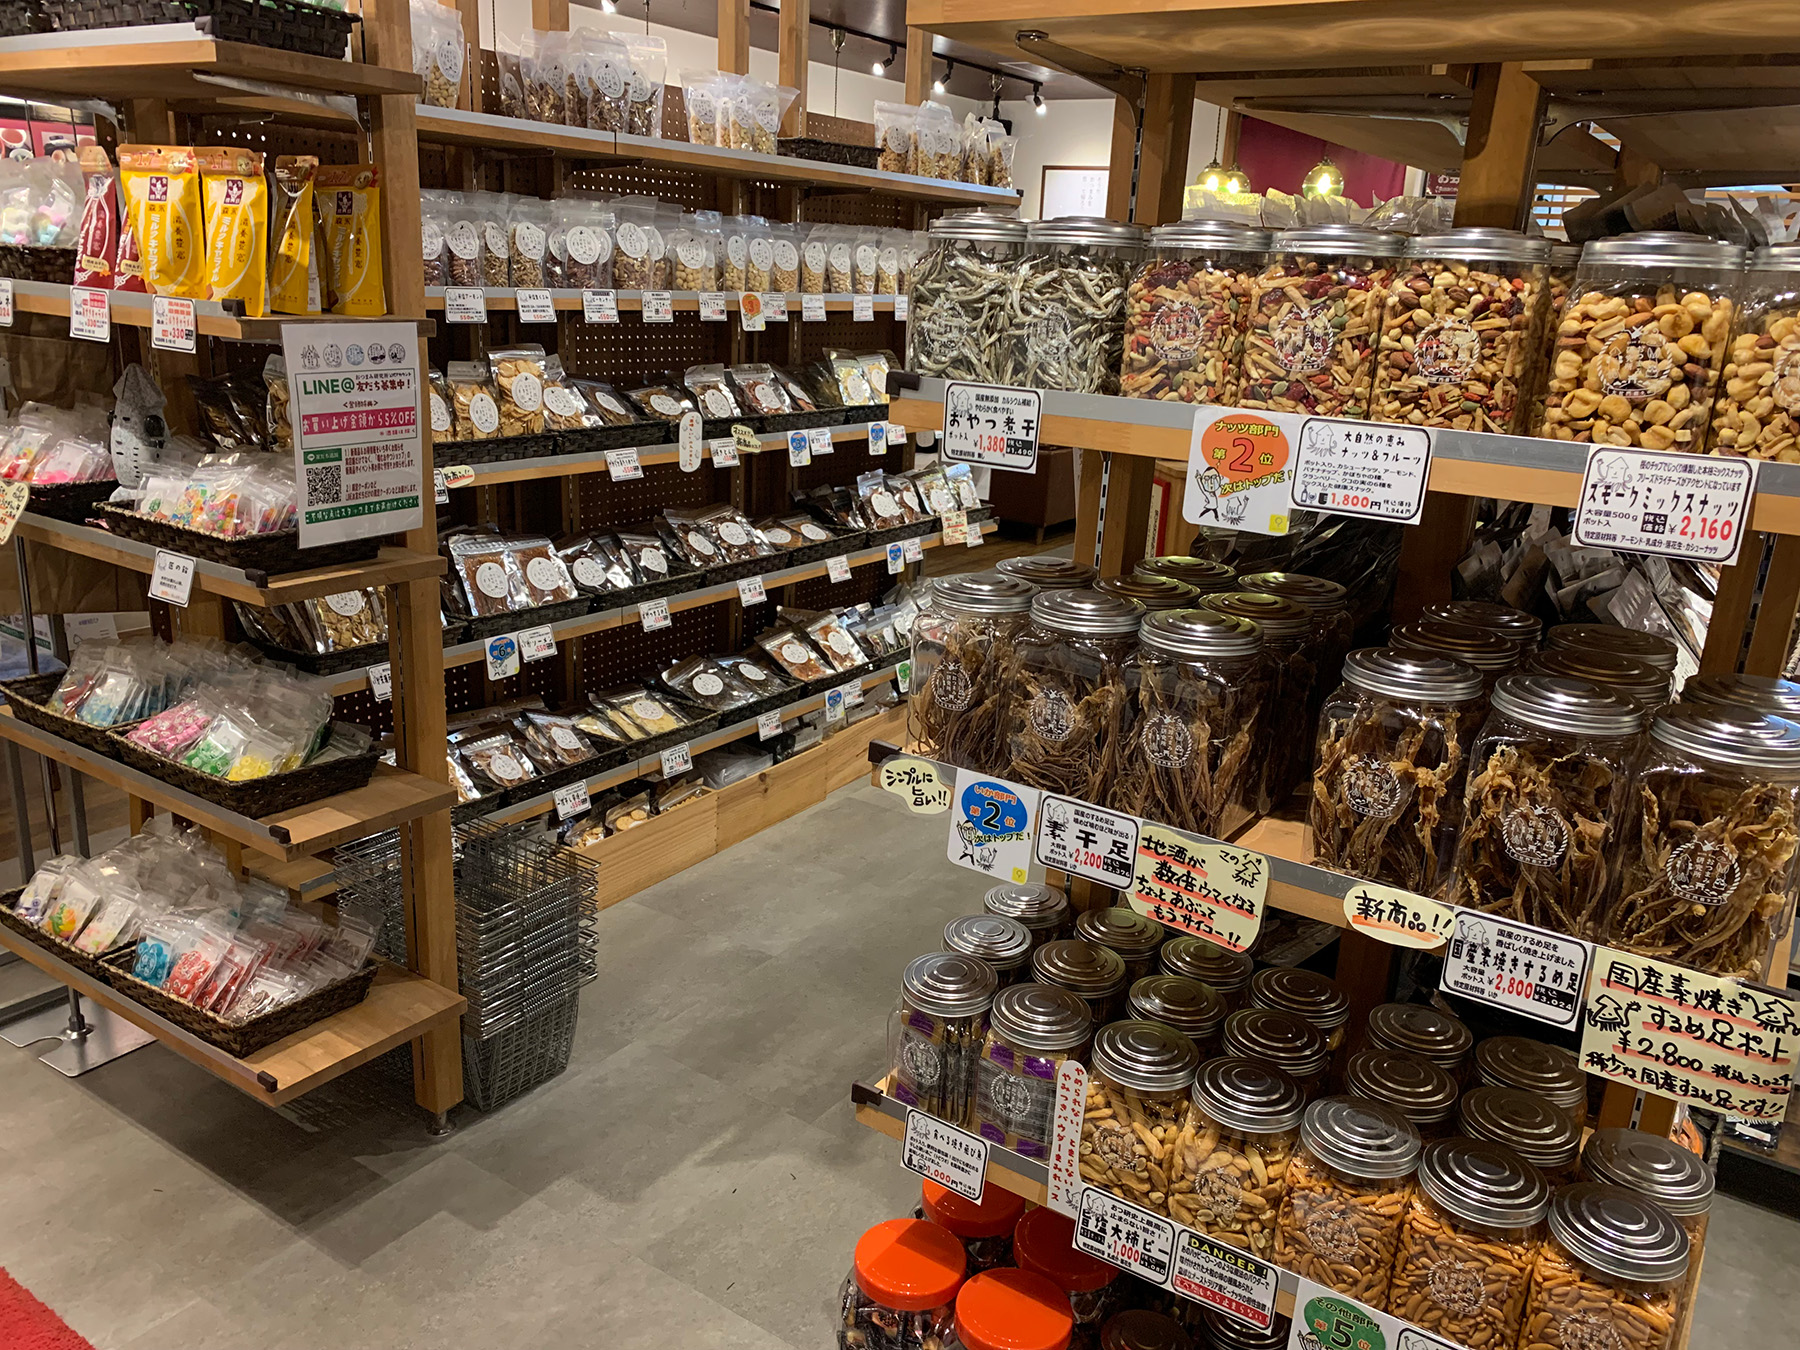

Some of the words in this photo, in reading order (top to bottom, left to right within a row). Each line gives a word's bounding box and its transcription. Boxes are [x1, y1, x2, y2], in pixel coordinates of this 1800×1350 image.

[148, 214, 161, 281] ミルクキャラメル
[211, 216, 231, 282] ミルクキャラメル
[303, 377, 355, 395] LINE@
[949, 411, 1035, 437] おやつ煮干
[1215, 420, 1280, 437] ナッツ部門
[973, 434, 1005, 453] ¥1,380
[1344, 431, 1405, 447] 大自然の恵み
[1341, 447, 1421, 464] ナッツ&フルーツ
[1221, 470, 1292, 494] 次はトップだ！
[1331, 492, 1381, 510] 1,800円
[1587, 483, 1738, 517] スモークミックスナッツ
[1582, 518, 1612, 528] ポット入
[1669, 515, 1733, 541] ¥2,160
[498, 645, 506, 657] 6
[885, 767, 933, 787] シンプルに
[911, 786, 947, 807] 旨い!!
[974, 785, 1018, 805] いか部門
[973, 831, 1031, 844] 次はトップだ！
[1044, 819, 1130, 861] 素干足
[1069, 848, 1102, 869] ¥2,200
[1141, 835, 1206, 869] 地酒が
[1354, 890, 1453, 936] 新商品!!
[1497, 928, 1559, 953] 国産のするめ足を
[1495, 939, 1576, 969] 香ばしく焼き上げました
[1452, 940, 1579, 993] 国産素焼きするめ足
[1463, 964, 1485, 977] 大容量
[1461, 973, 1485, 985] ポット入
[1488, 973, 1533, 999] ¥2,800
[1606, 960, 1743, 1017] 国産素焼き
[1647, 1005, 1789, 1062] するめ足ポット
[1618, 1030, 1703, 1071] ¥2,800
[1107, 1240, 1140, 1264] ¥1,000
[1314, 1297, 1381, 1332] その他部門
